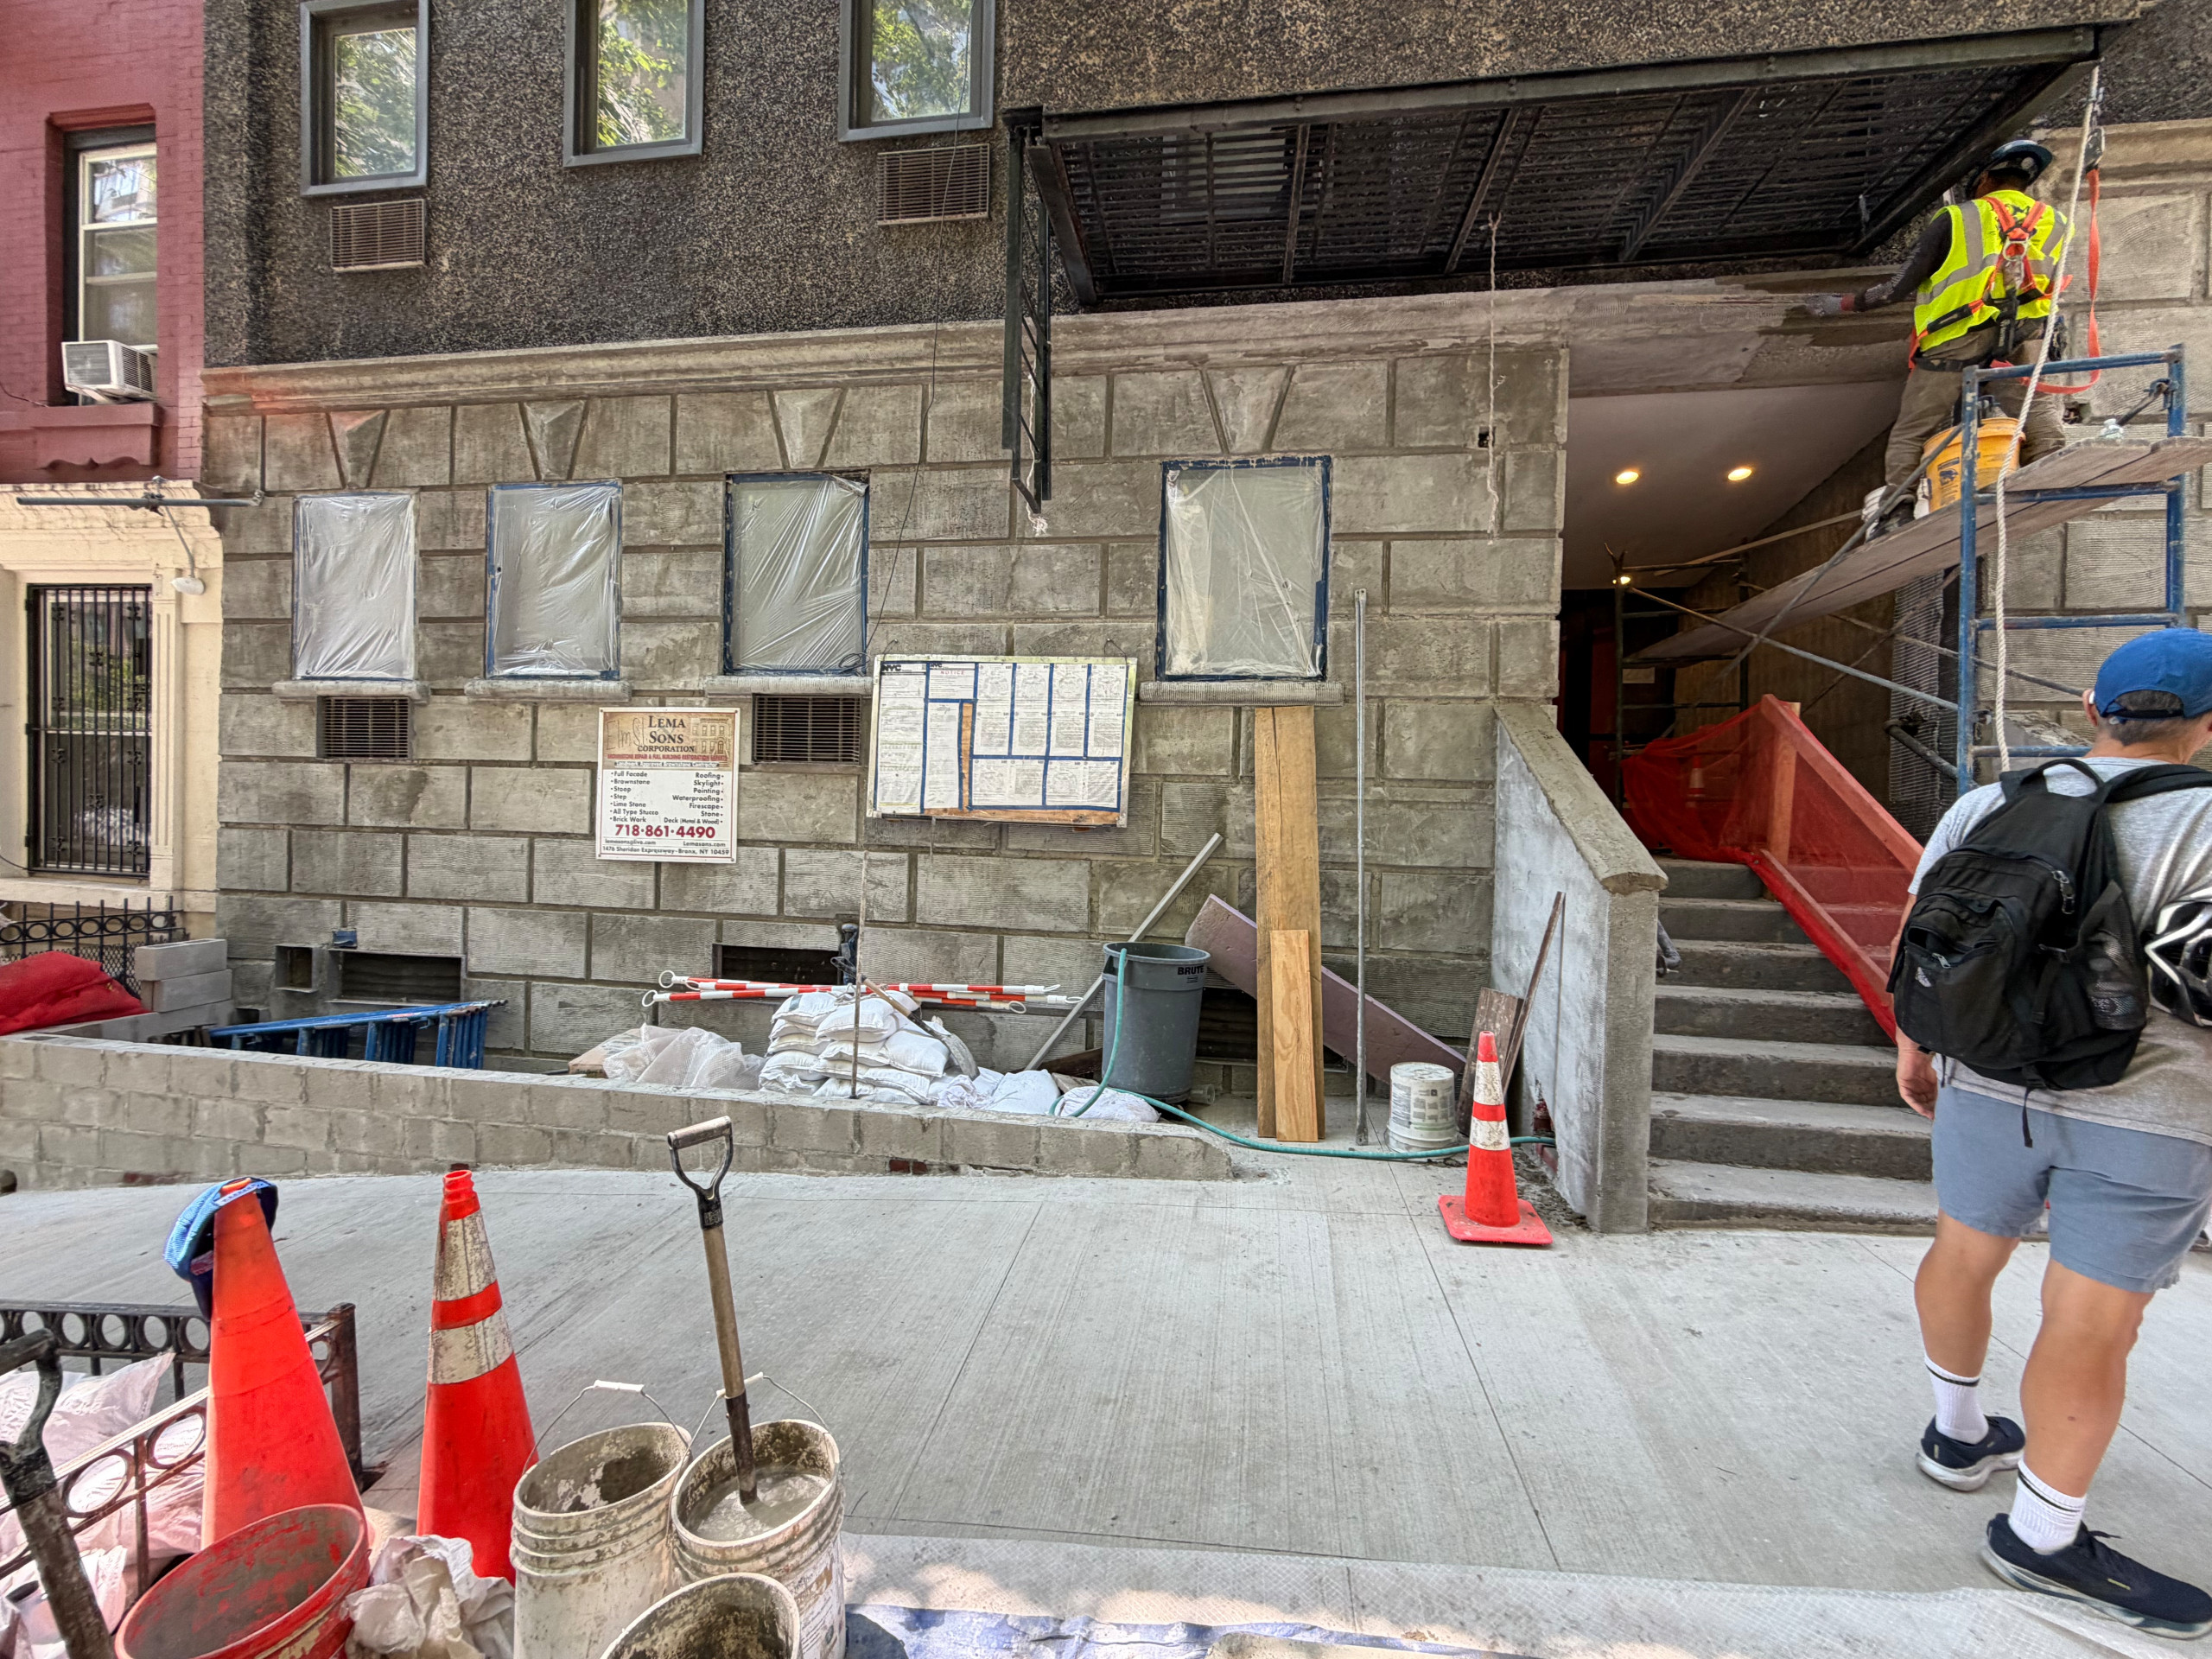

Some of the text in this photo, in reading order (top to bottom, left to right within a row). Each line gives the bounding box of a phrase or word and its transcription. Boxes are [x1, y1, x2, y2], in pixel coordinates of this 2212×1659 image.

[648, 715, 686, 728] LEMA
[649, 730, 684, 744] SONS
[1177, 964, 1205, 975] BRUTE
